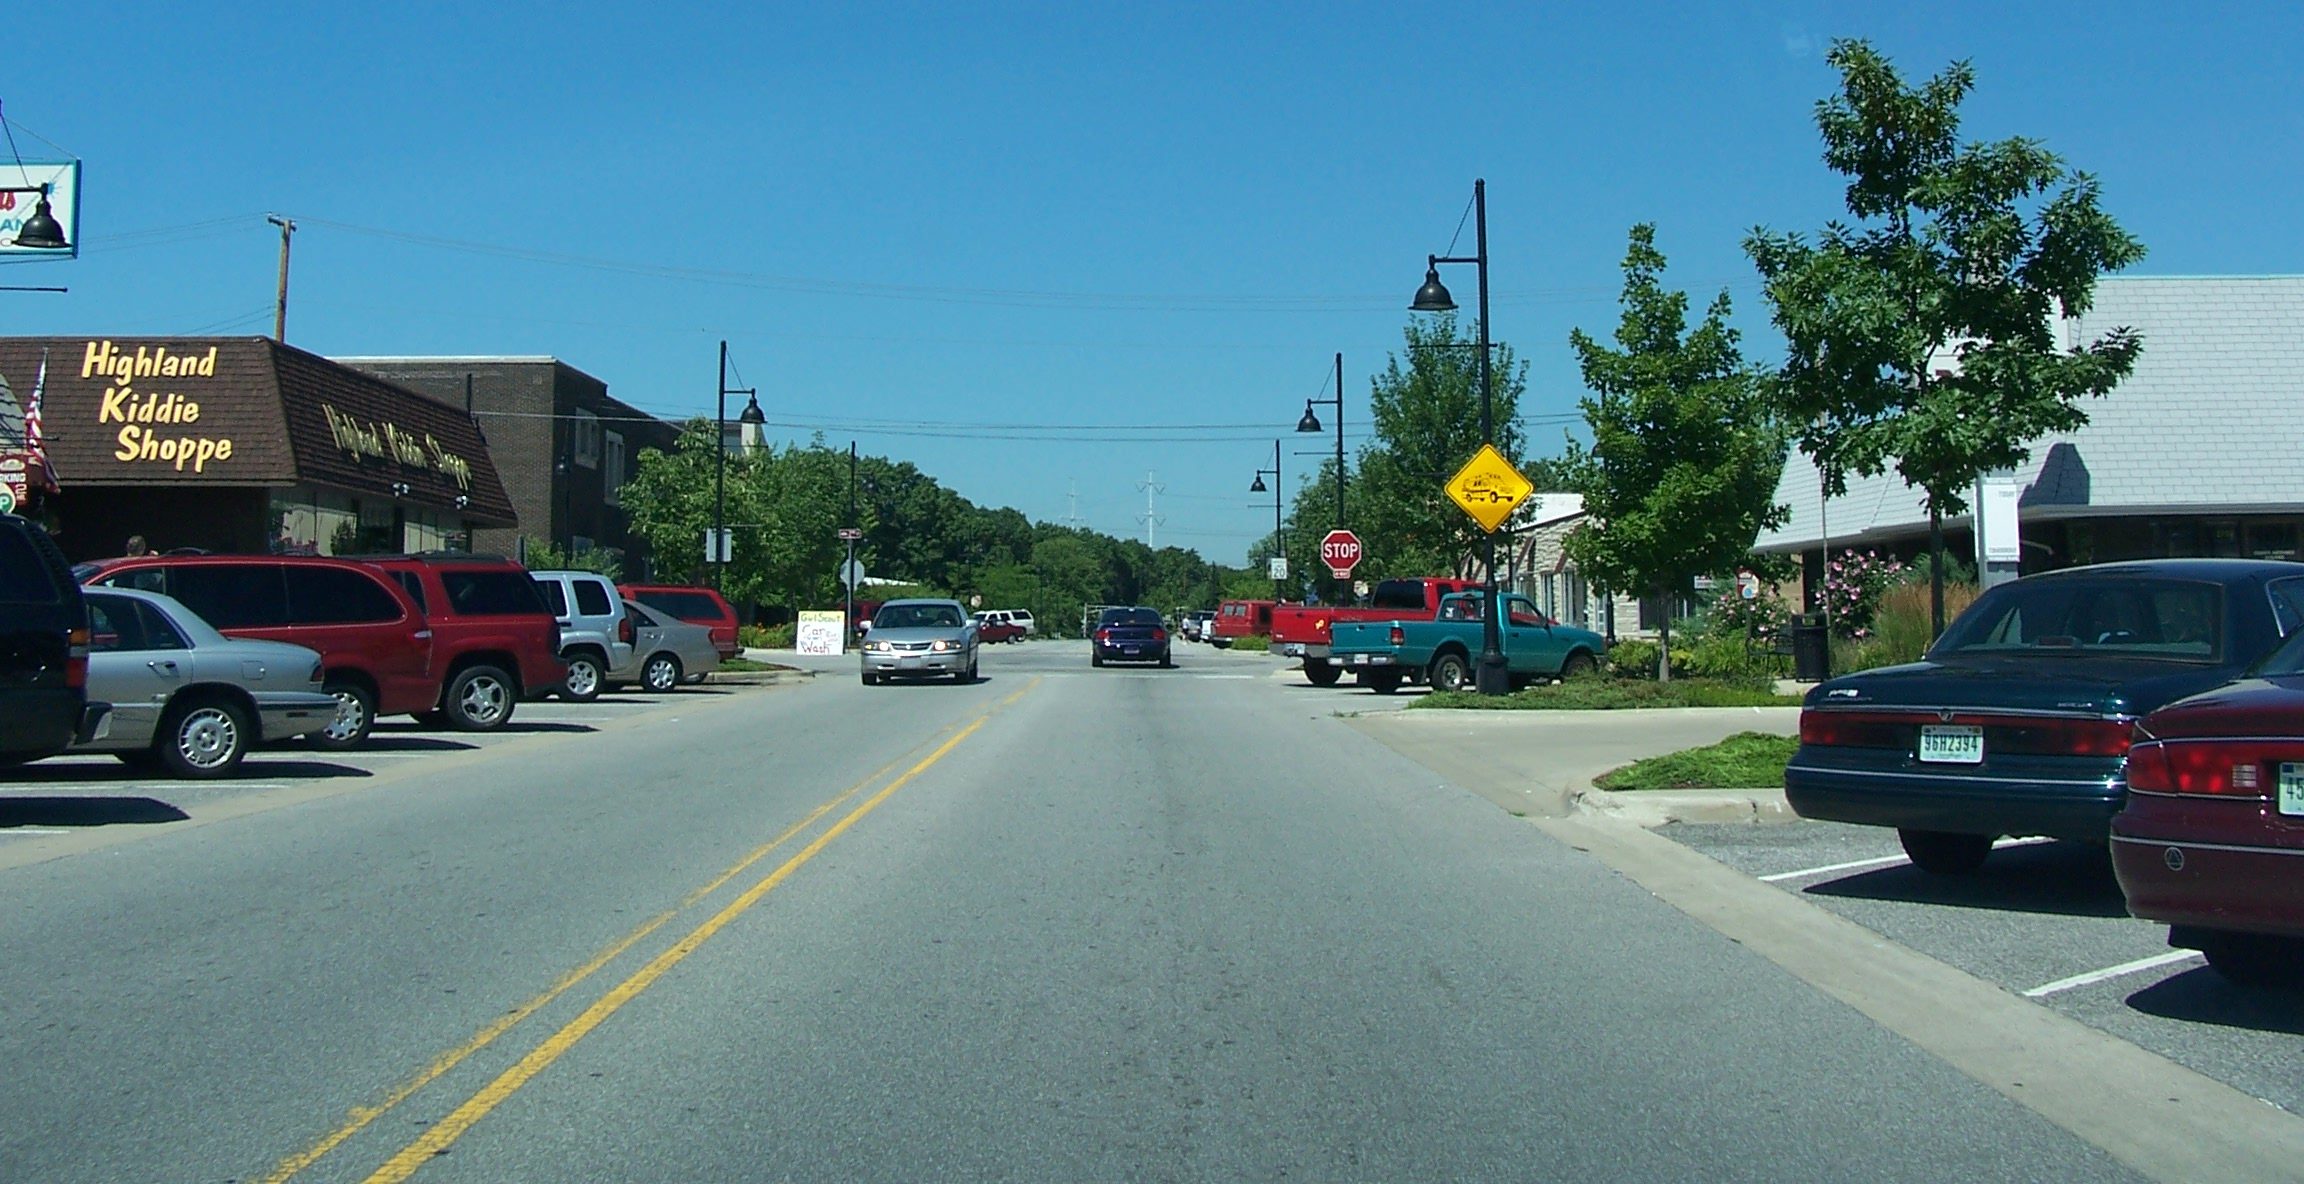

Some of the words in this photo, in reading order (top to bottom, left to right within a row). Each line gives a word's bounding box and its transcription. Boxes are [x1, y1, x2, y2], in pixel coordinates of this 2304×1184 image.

[81, 340, 217, 386] Highland
[99, 387, 200, 424] Kiddie
[114, 424, 232, 473] Shoppe
[1324, 543, 1358, 558] STOP
[1273, 567, 1286, 578] 20
[802, 624, 826, 636] Car
[800, 641, 830, 654] Wash
[1924, 734, 1978, 753] 96H2394
